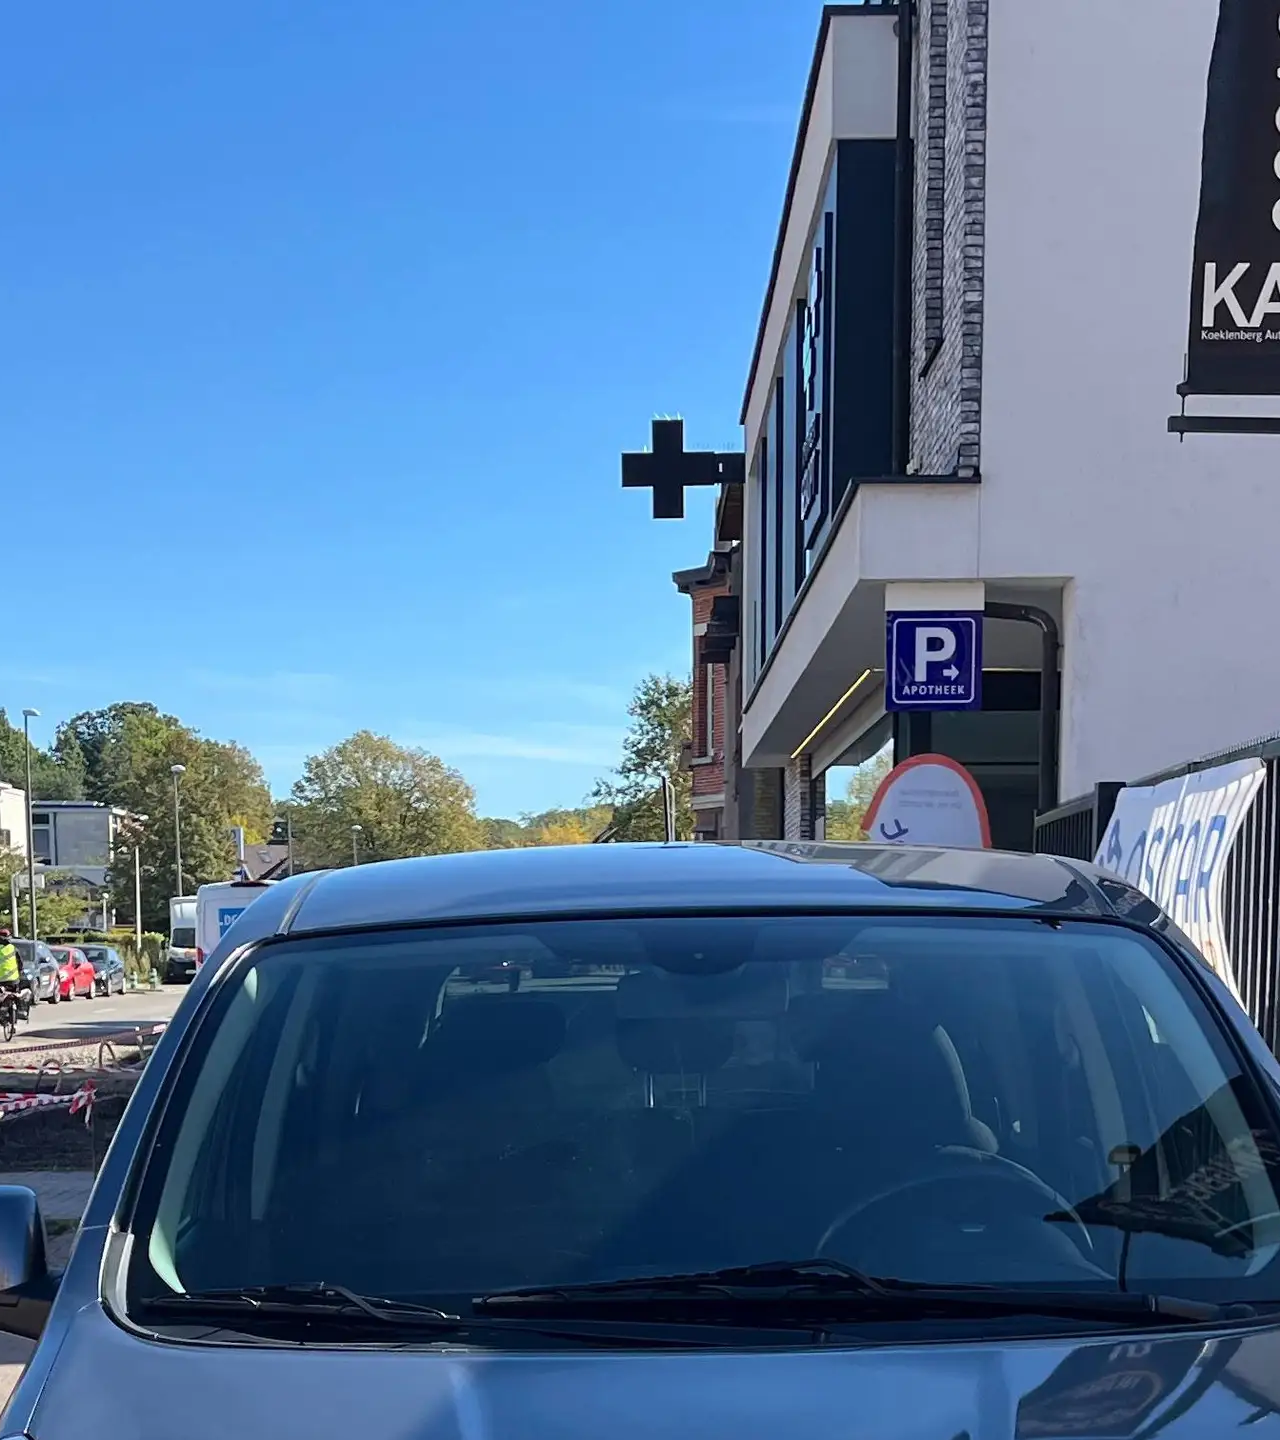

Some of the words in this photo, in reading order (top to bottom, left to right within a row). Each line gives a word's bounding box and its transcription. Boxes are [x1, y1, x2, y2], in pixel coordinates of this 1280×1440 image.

[1200, 329, 1263, 343] Koeklenberg
[914, 626, 957, 682] P
[901, 684, 965, 696] APOTHEEK
